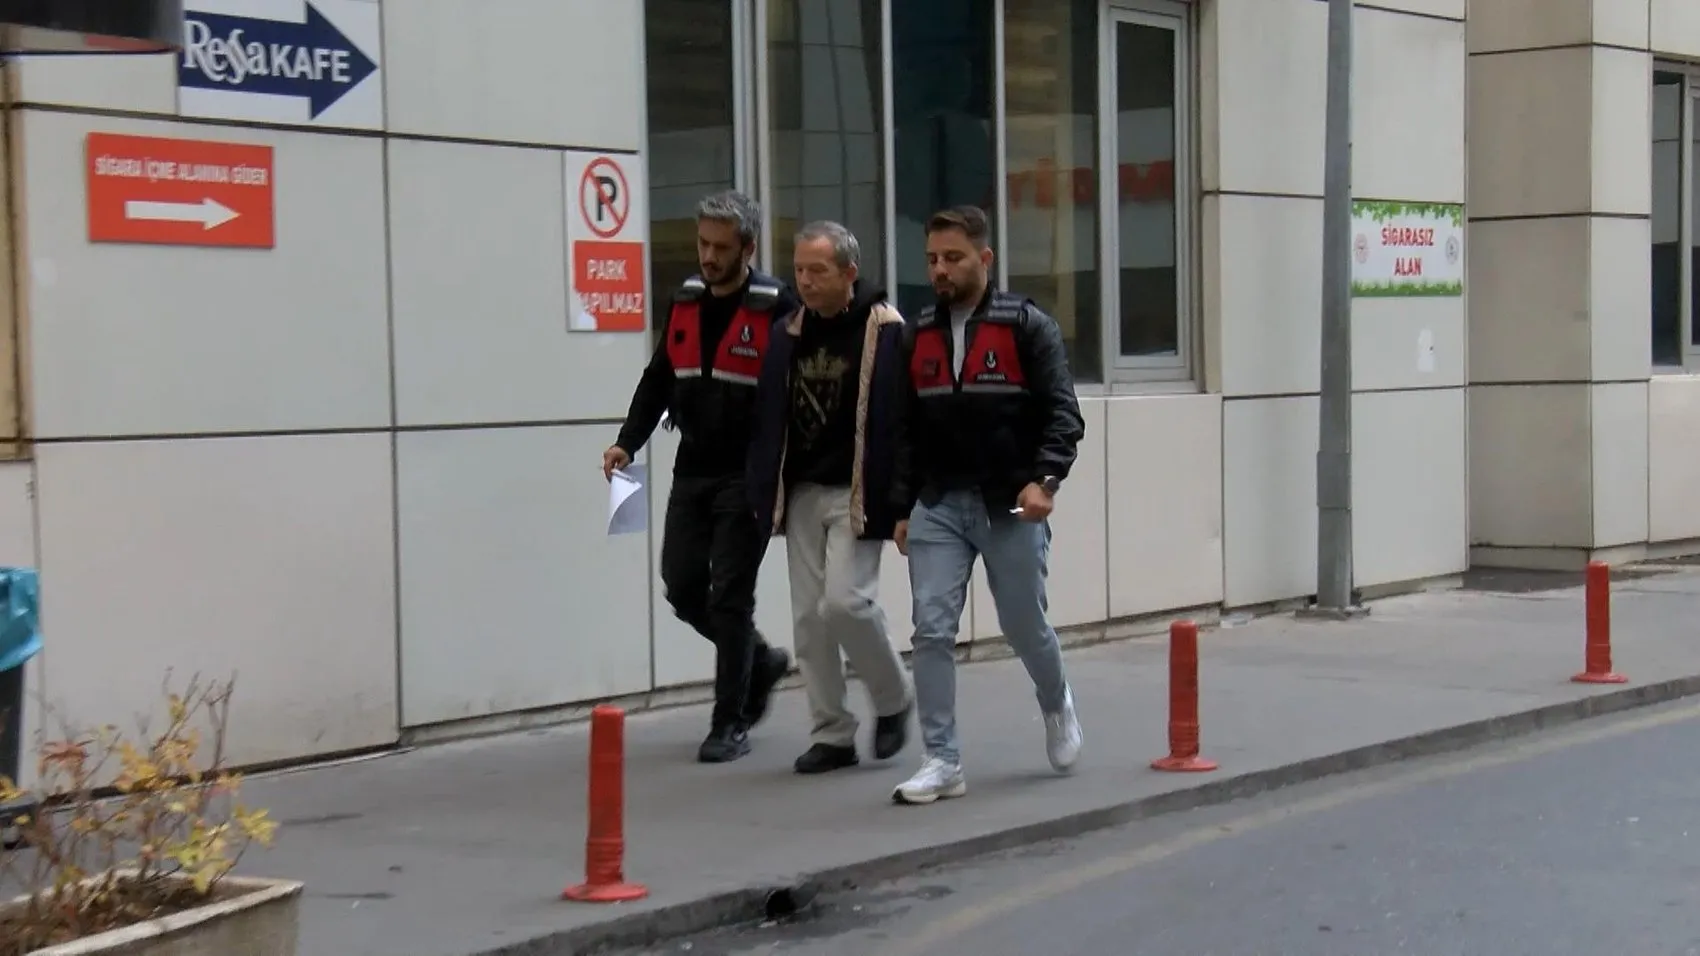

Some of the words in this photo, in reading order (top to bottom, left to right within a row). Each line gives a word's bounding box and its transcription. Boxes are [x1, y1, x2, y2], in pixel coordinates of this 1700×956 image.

[270, 43, 351, 83] KAFE
[1381, 222, 1435, 247] SİGARASIZ
[587, 259, 627, 280] PARK
[1394, 257, 1422, 276] ALAN
